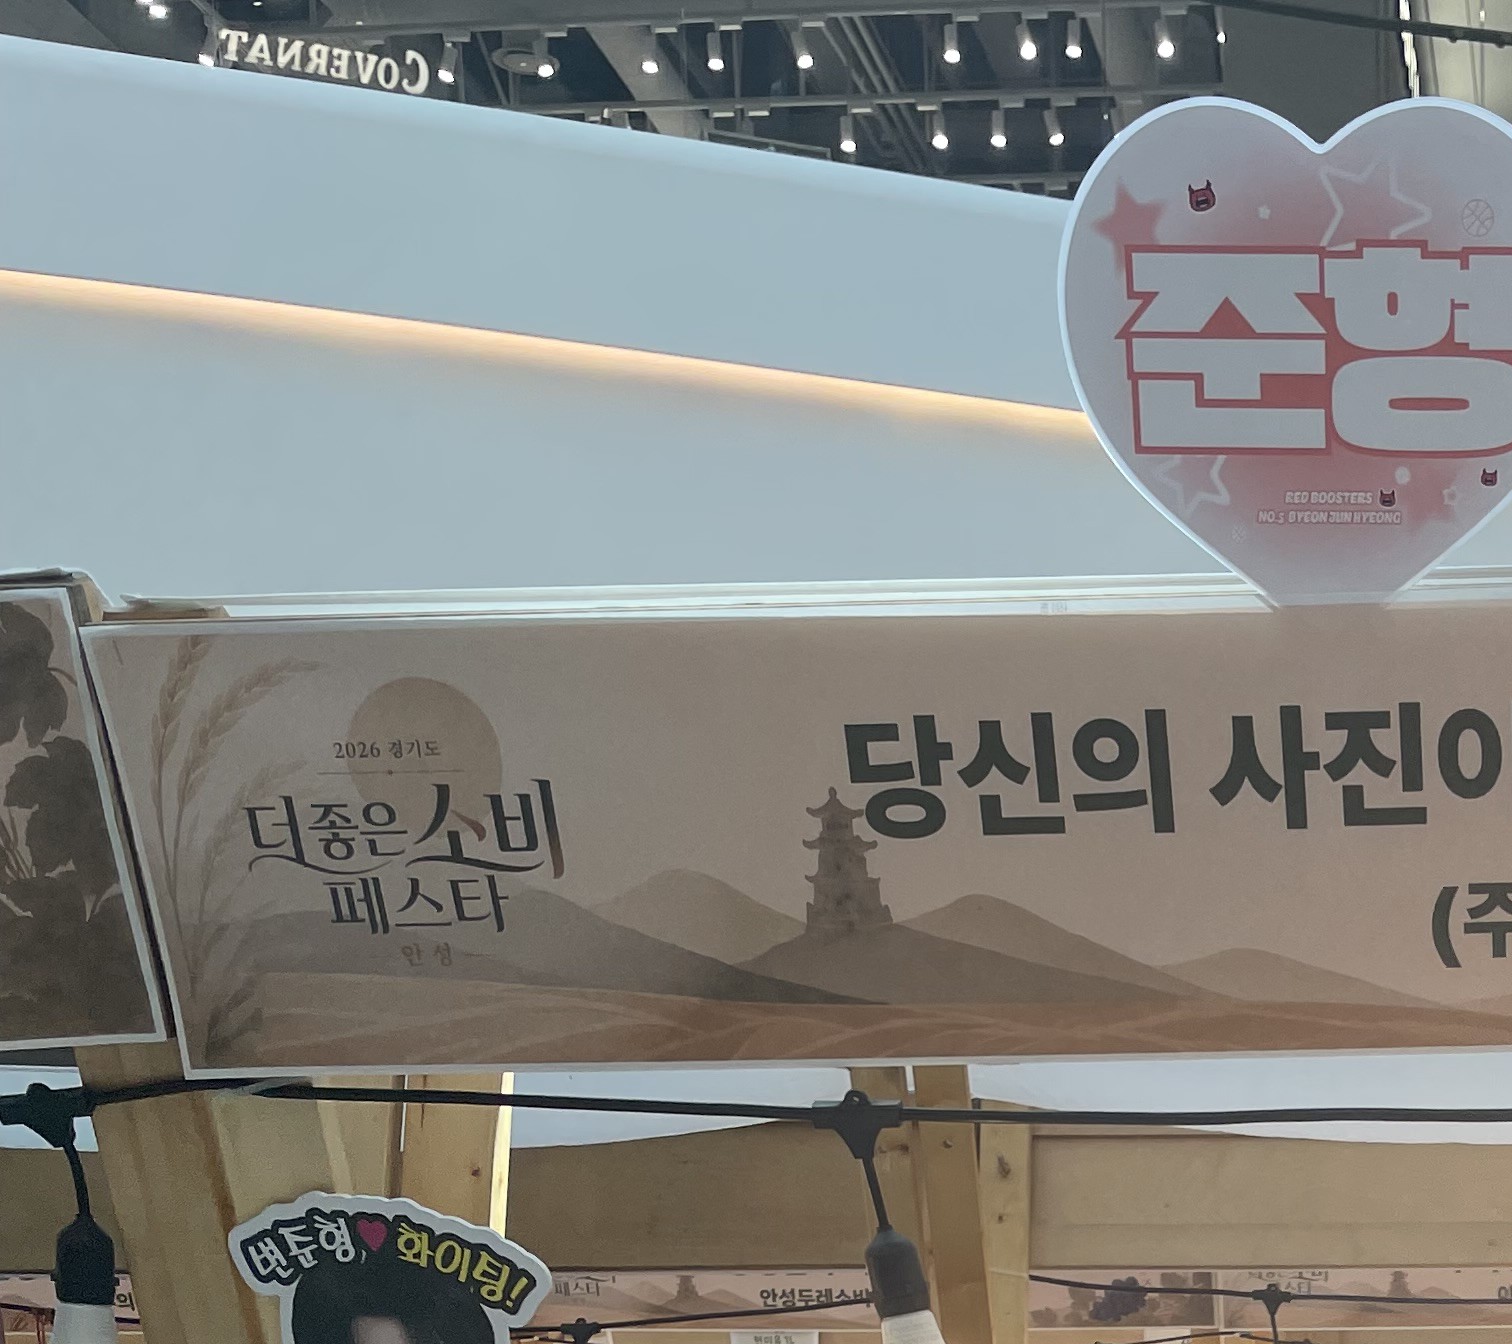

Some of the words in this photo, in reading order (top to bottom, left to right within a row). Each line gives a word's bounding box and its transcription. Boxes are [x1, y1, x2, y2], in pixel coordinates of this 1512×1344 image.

[1285, 491, 1308, 504] RED
[1310, 491, 1372, 504] BOOSTERS
[334, 742, 380, 758] 2026
[388, 740, 441, 759] 경기도
[844, 709, 1175, 838] 당신의
[329, 873, 509, 934] 페스타
[401, 943, 452, 967] 안성
[397, 1222, 528, 1307] 화이팅!
